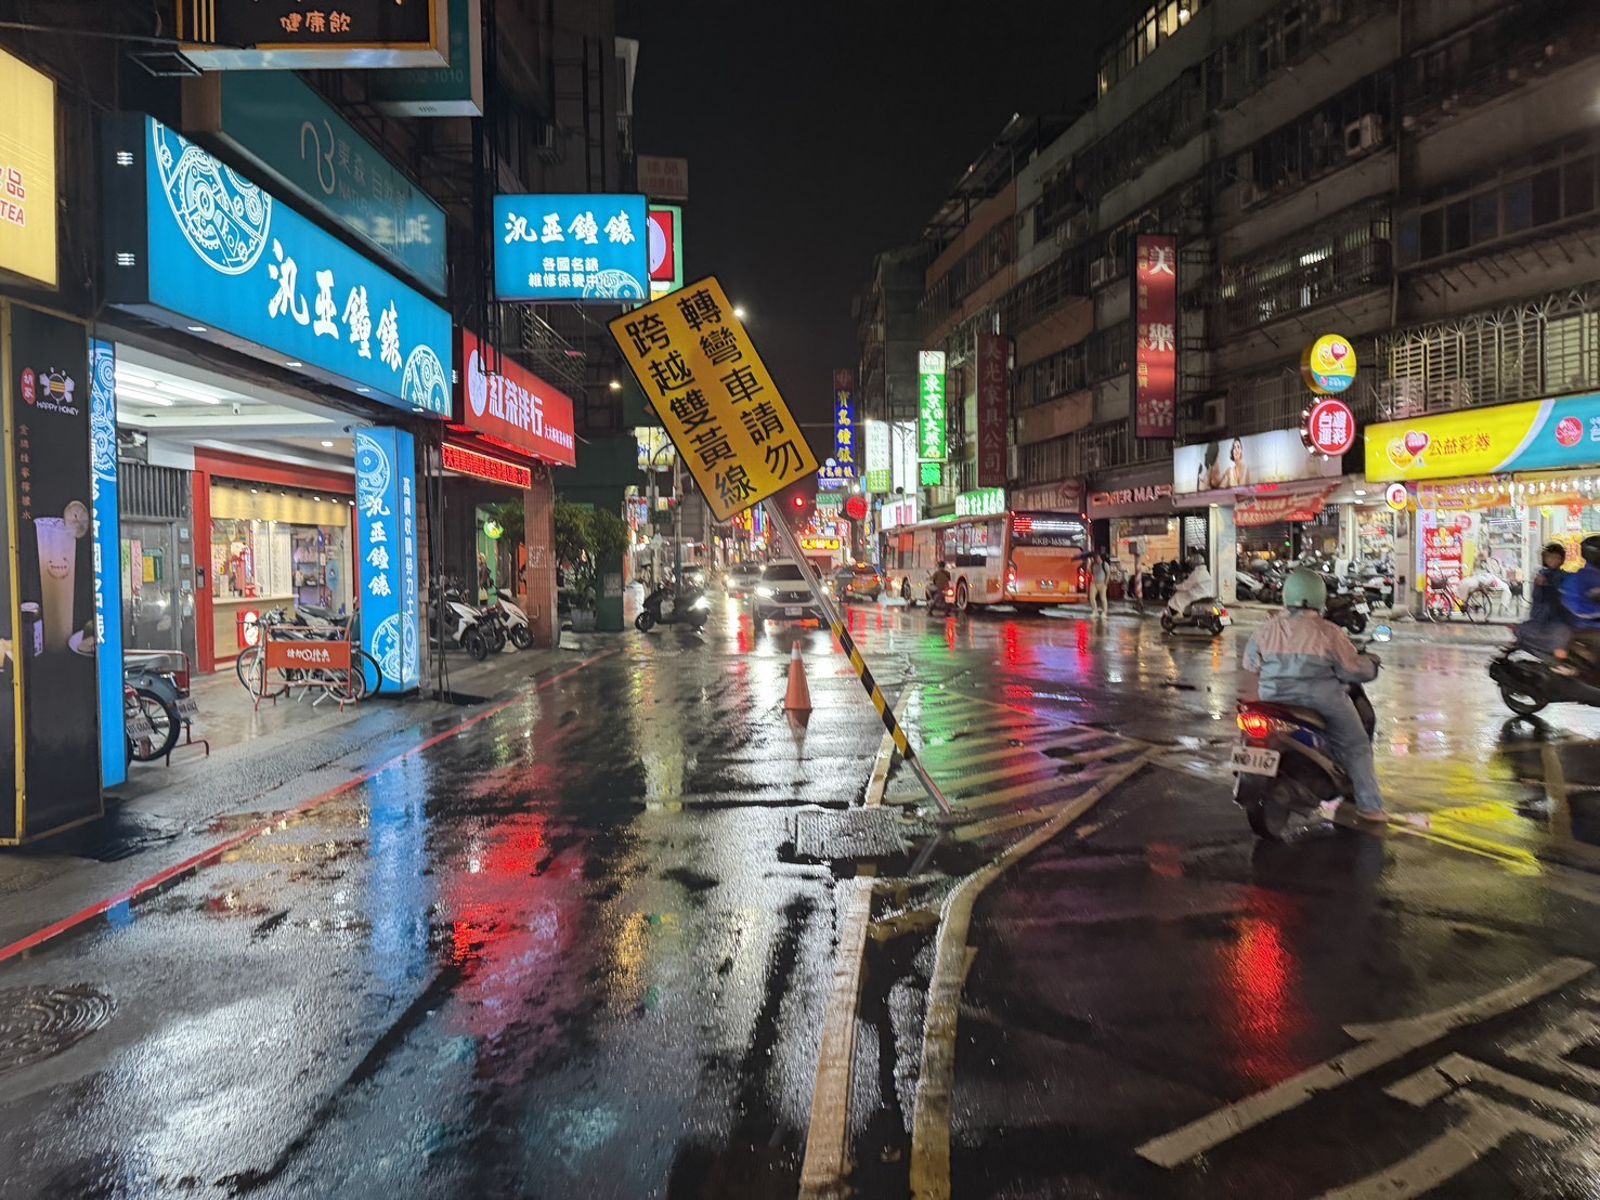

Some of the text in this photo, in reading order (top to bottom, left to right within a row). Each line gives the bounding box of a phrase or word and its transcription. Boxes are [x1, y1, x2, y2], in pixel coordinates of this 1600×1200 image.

[280, 11, 351, 32] 健康飲
[0, 199, 25, 226] TEA
[488, 372, 544, 437] 紅茶洋行
[625, 313, 758, 509] 跨越雙黃線
[677, 288, 804, 480] 轉彎車請勿
